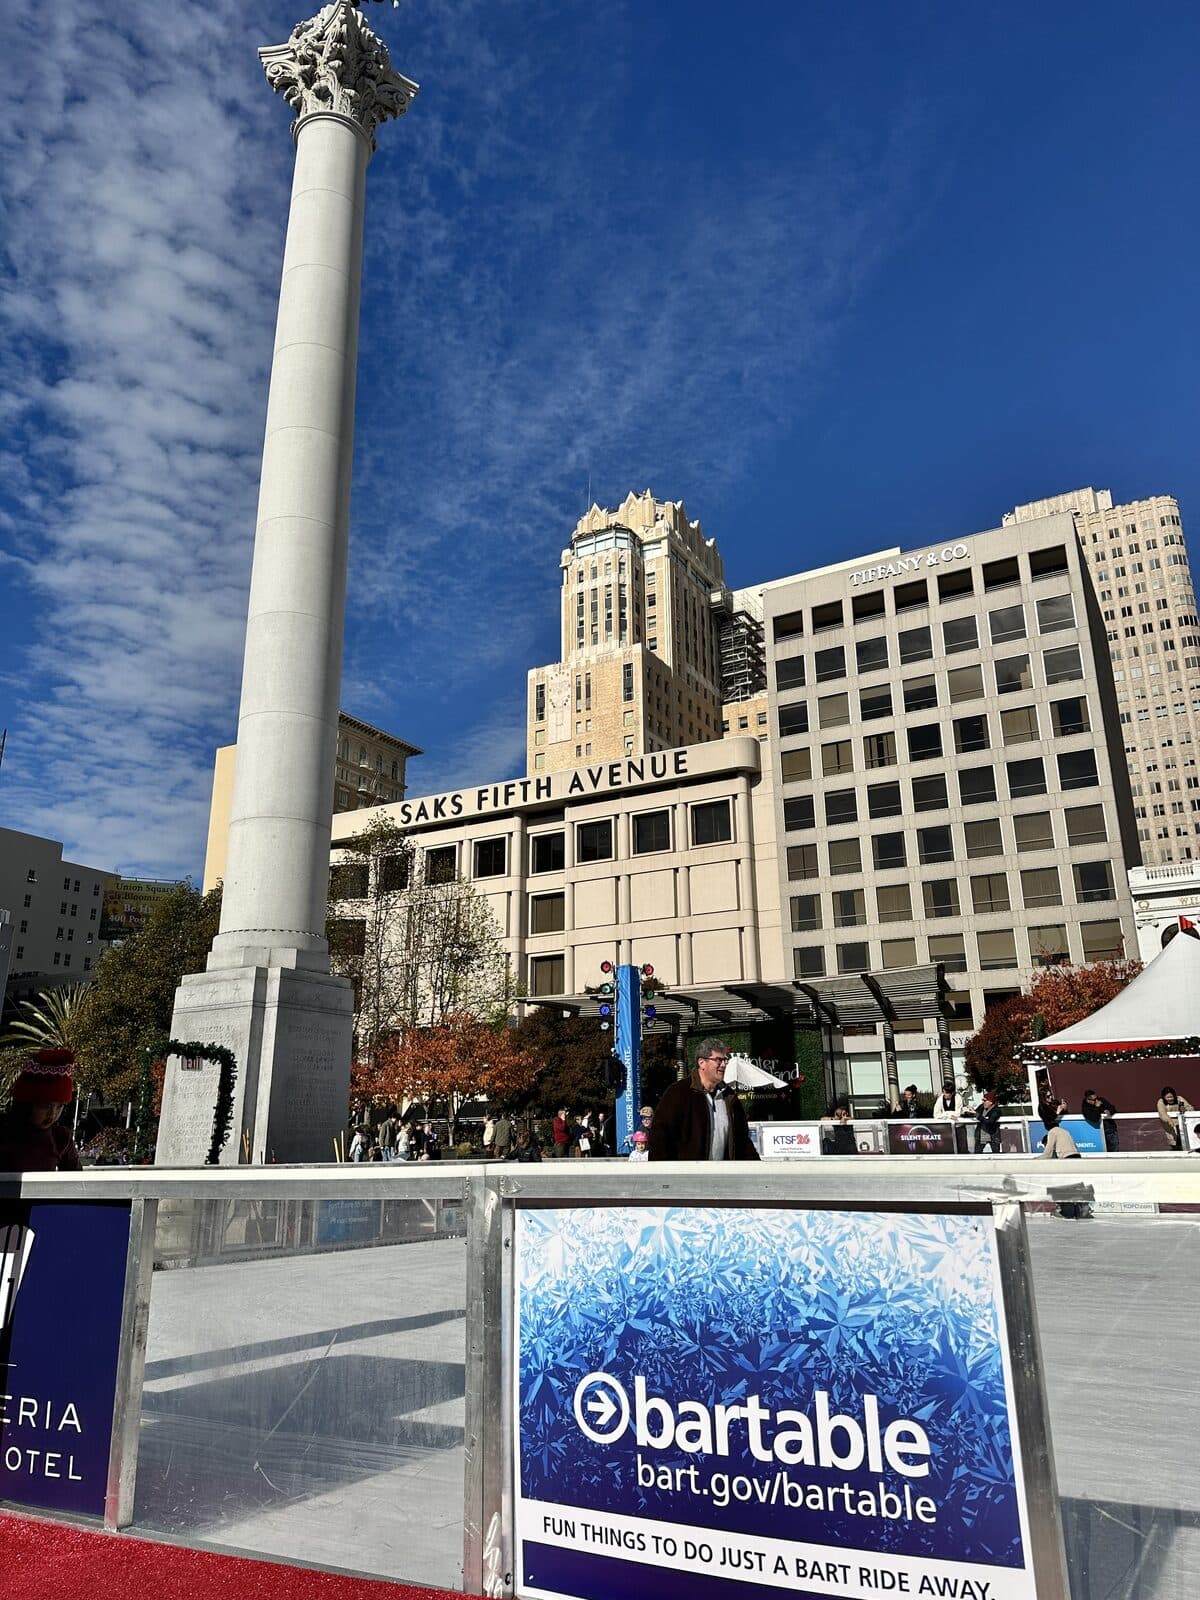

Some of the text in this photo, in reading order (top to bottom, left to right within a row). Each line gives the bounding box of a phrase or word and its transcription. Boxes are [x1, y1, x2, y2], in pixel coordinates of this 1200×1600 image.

[849, 554, 923, 587] TIFFANY
[926, 552, 938, 567] &
[400, 750, 688, 825] SAKS FIFTH AVENUE
[116, 883, 175, 894] Union Square
[927, 1036, 964, 1046] TINY
[626, 1104, 634, 1131] KAISER
[634, 1375, 932, 1478] bartable
[5, 1446, 82, 1481] OTEL
[636, 1453, 937, 1524] bart.gov/bartable
[543, 1516, 996, 1600] FUN THINGS TO DO JUST A BART RIDE AWAY.
